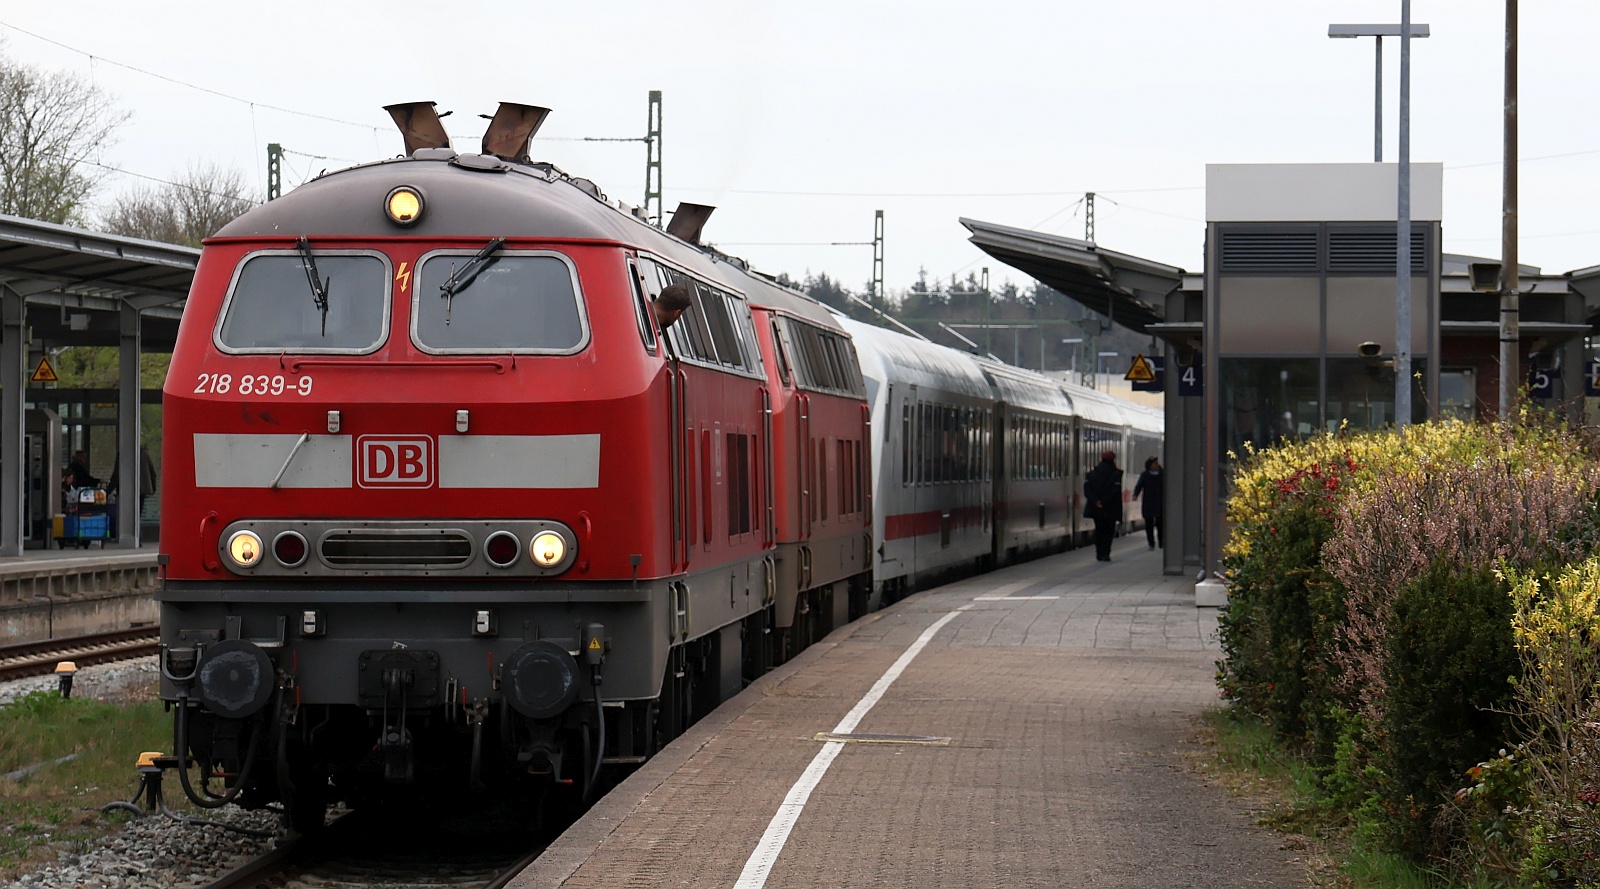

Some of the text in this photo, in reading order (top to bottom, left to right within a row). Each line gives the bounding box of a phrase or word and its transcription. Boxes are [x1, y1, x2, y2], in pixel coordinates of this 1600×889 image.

[193, 373, 313, 397] 218 839-9
[1182, 367, 1196, 387] 4
[1535, 371, 1550, 389] 5
[368, 444, 424, 479] DB
